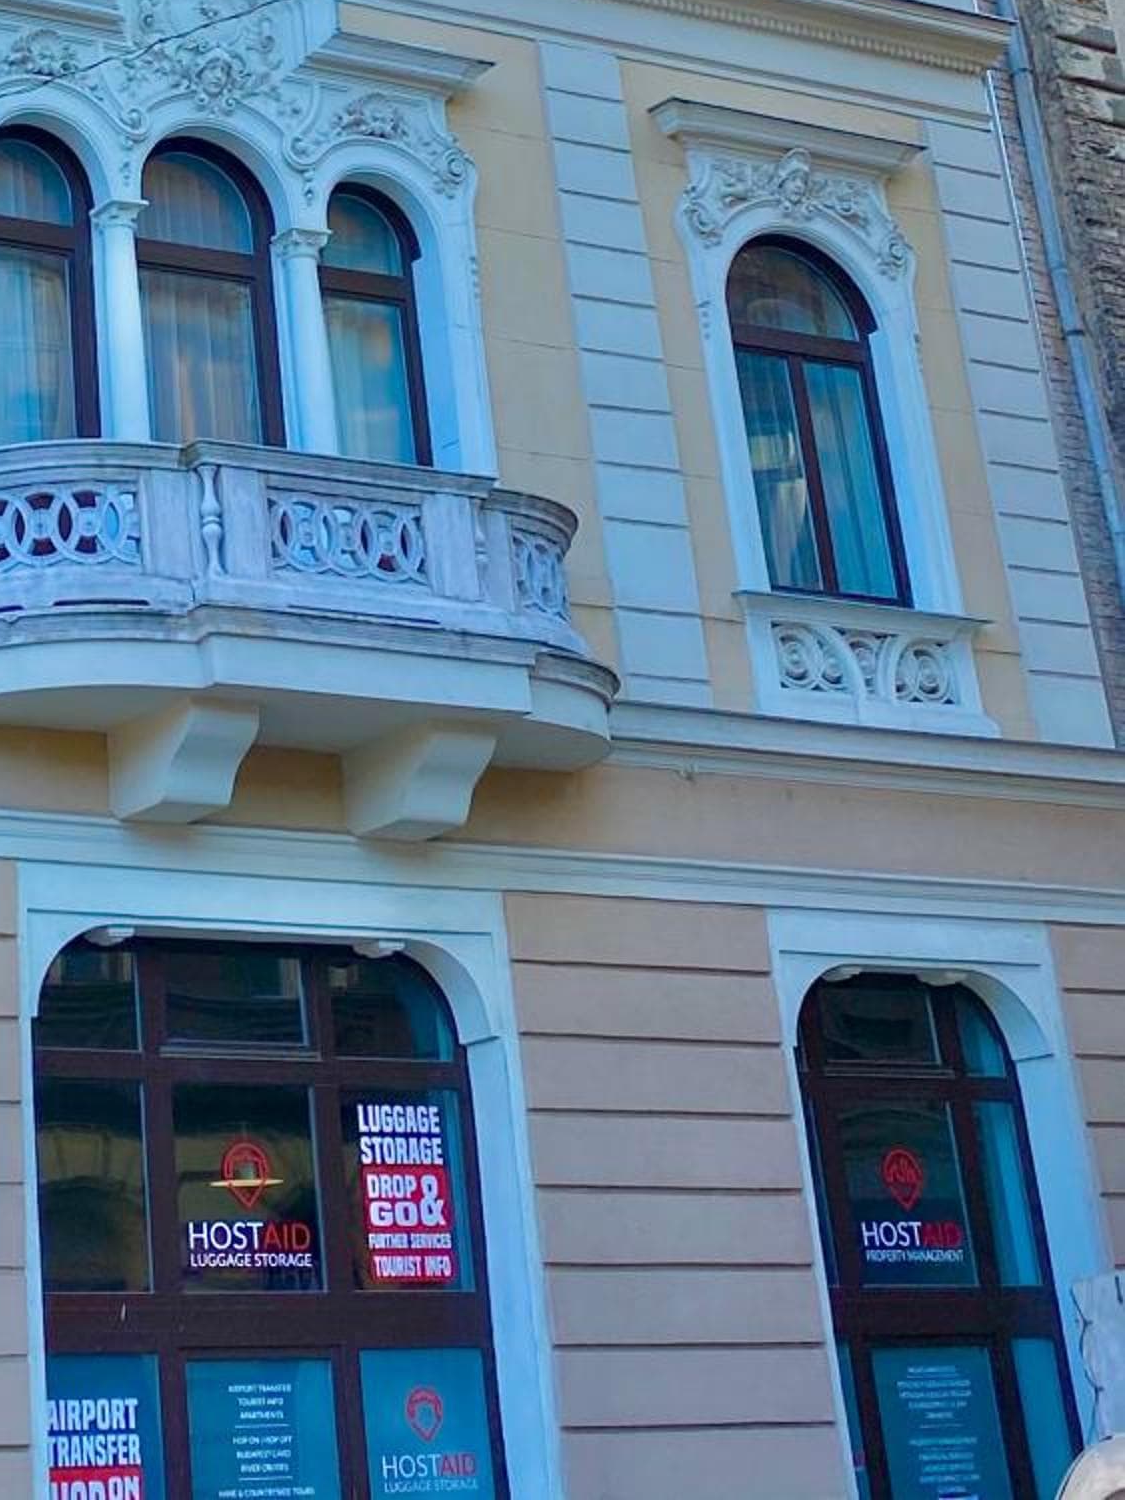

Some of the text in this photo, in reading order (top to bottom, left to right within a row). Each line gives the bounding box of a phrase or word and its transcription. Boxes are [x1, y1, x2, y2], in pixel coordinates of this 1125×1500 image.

[357, 1104, 441, 1133] LUGGAGE
[360, 1137, 444, 1165] STORAGE
[366, 1173, 447, 1227] DROP &
[369, 1201, 419, 1227] GO
[188, 1221, 311, 1251] HOSTAID
[190, 1253, 313, 1268] LUGGAGE STORAGE
[373, 1255, 452, 1277] TOURIST INFO
[46, 1398, 138, 1431] AIRPORT
[46, 1434, 141, 1467] TRANSFER
[382, 1453, 477, 1479] HOSTAID
